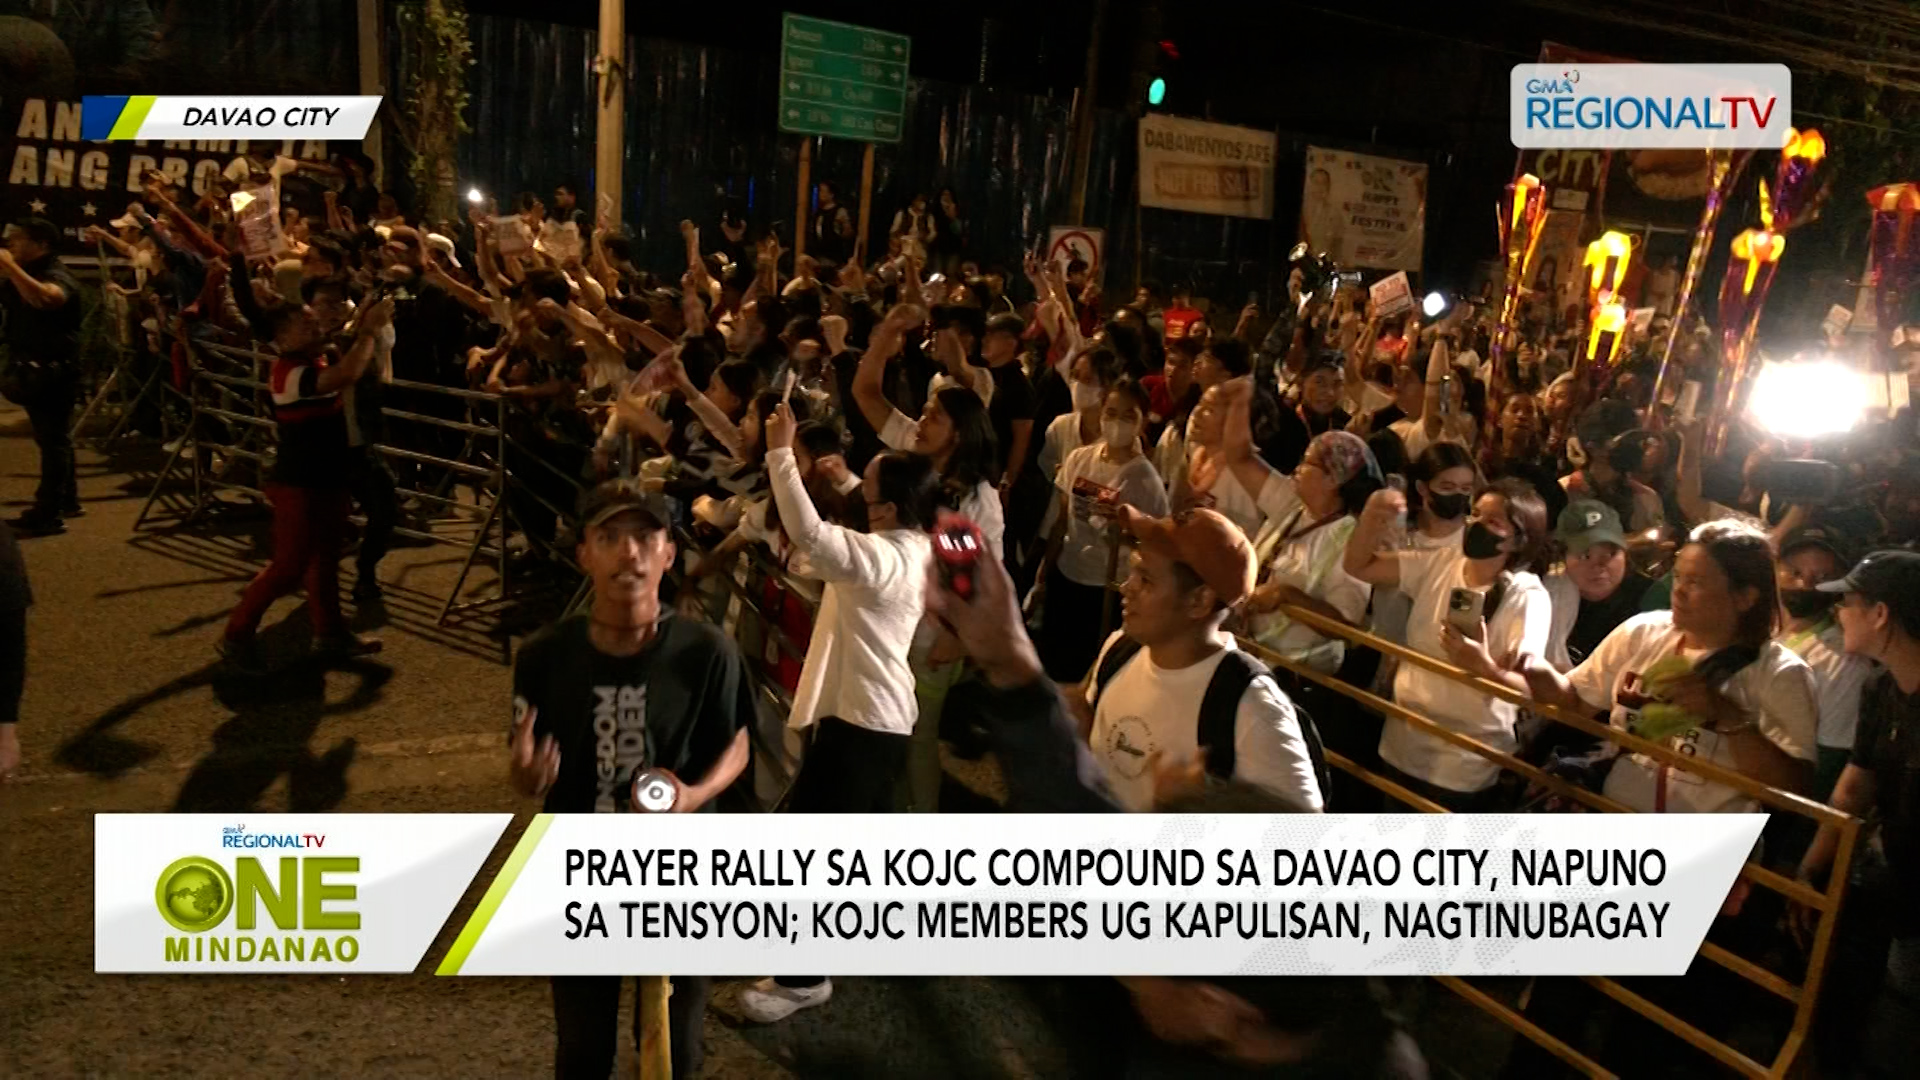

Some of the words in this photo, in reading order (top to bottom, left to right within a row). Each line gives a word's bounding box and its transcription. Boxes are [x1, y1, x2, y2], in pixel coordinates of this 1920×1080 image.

[16, 97, 84, 142] AN
[9, 145, 110, 192] ANG
[1585, 510, 1603, 526] P
